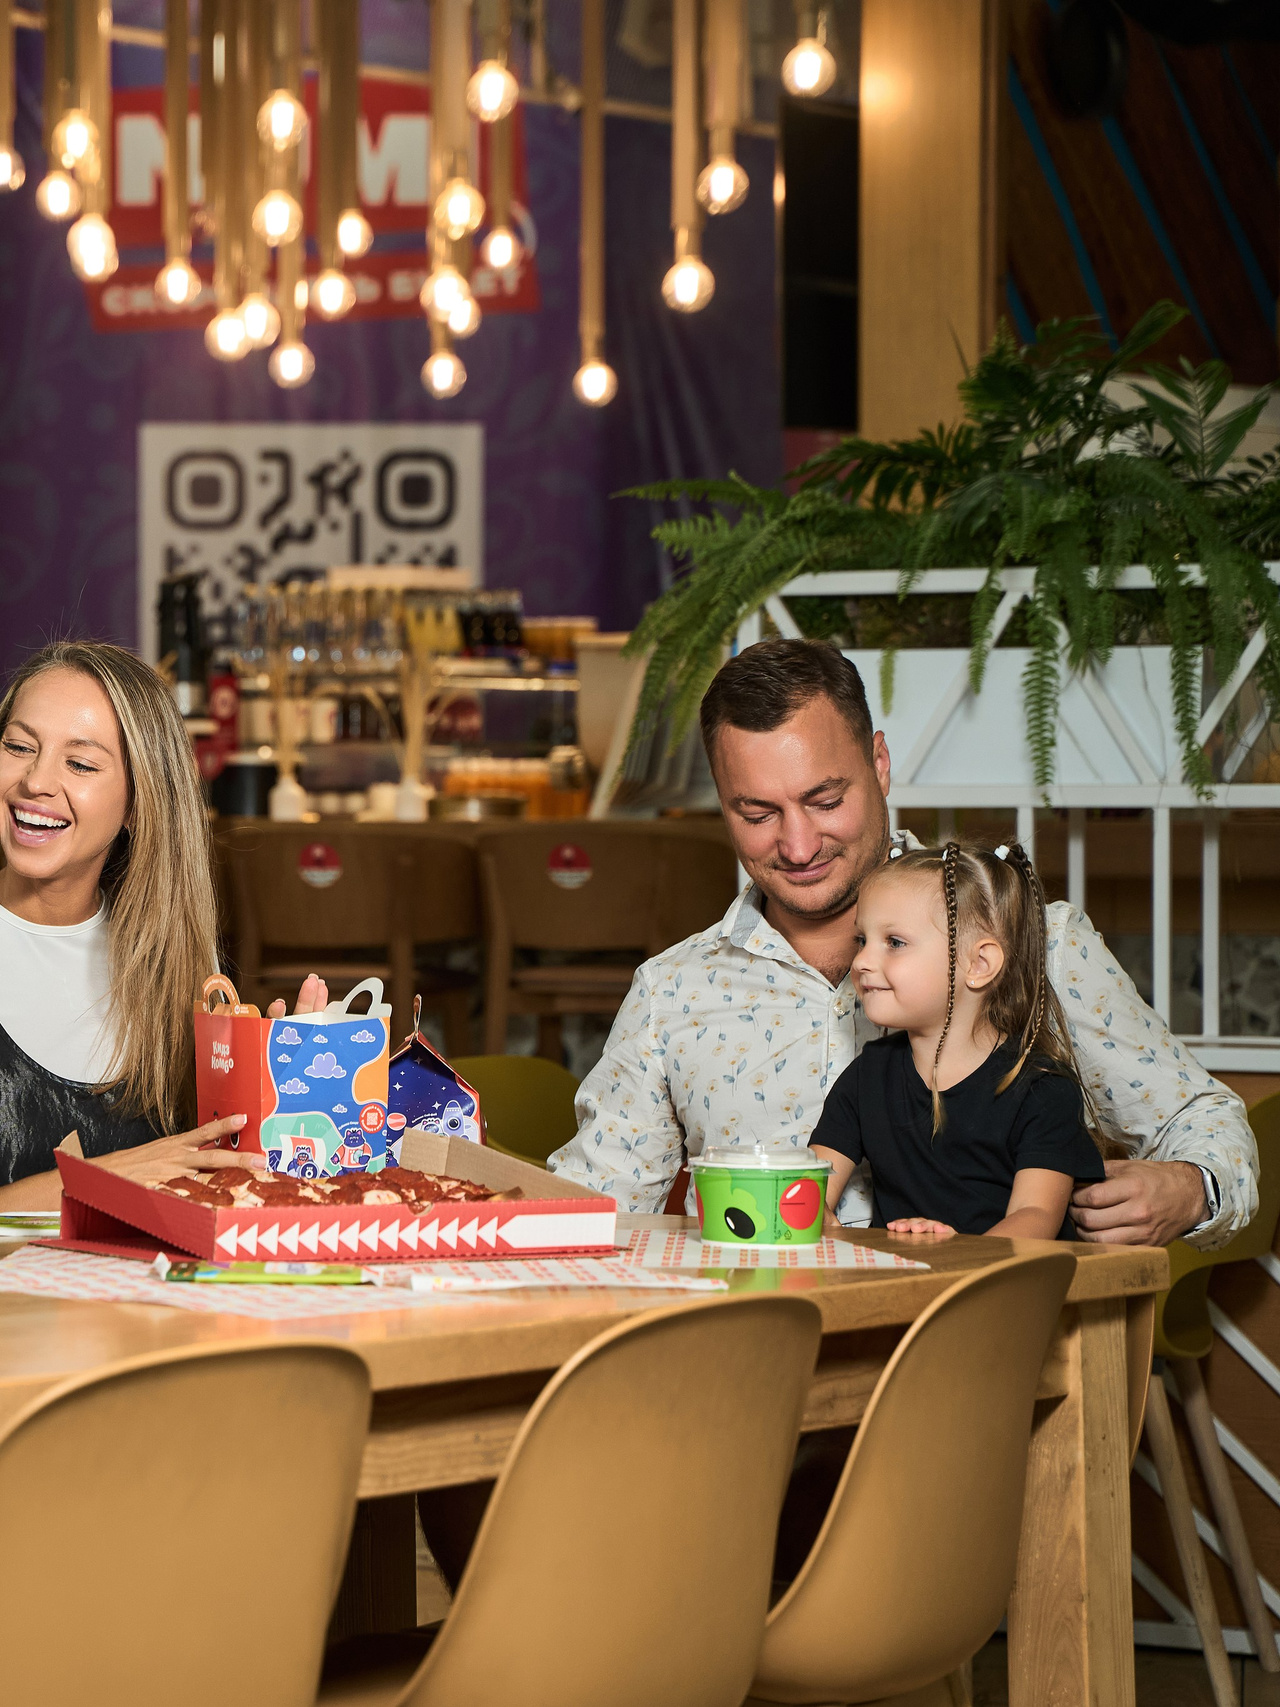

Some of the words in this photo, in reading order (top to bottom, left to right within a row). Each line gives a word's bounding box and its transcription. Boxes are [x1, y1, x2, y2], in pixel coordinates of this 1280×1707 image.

[117, 112, 480, 207] NM
[212, 1041, 230, 1057] Кидз
[211, 1055, 234, 1074] Комбо
